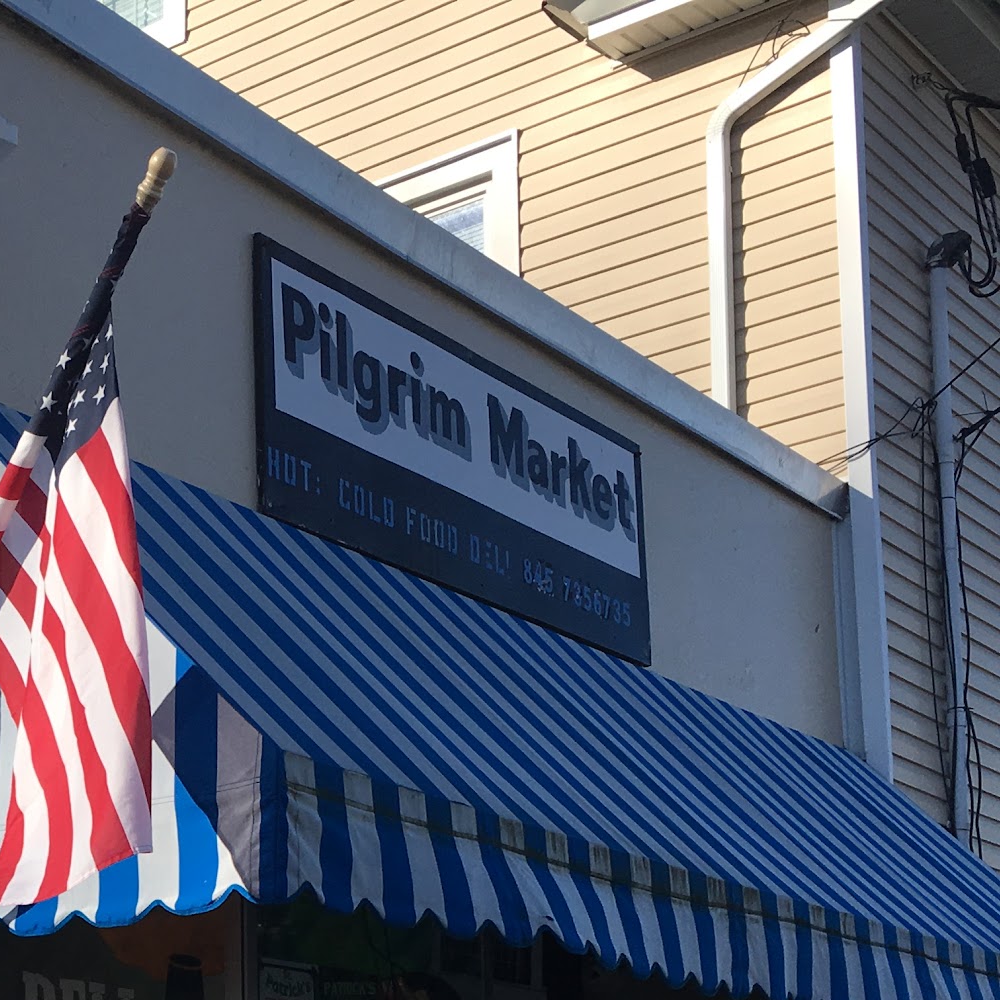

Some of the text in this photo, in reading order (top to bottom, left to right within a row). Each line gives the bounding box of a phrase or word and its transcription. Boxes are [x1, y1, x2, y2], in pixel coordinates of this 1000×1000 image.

[281, 282, 636, 543] Pilgrim Market
[338, 478, 395, 528] COLD
[406, 506, 458, 555] FOOD
